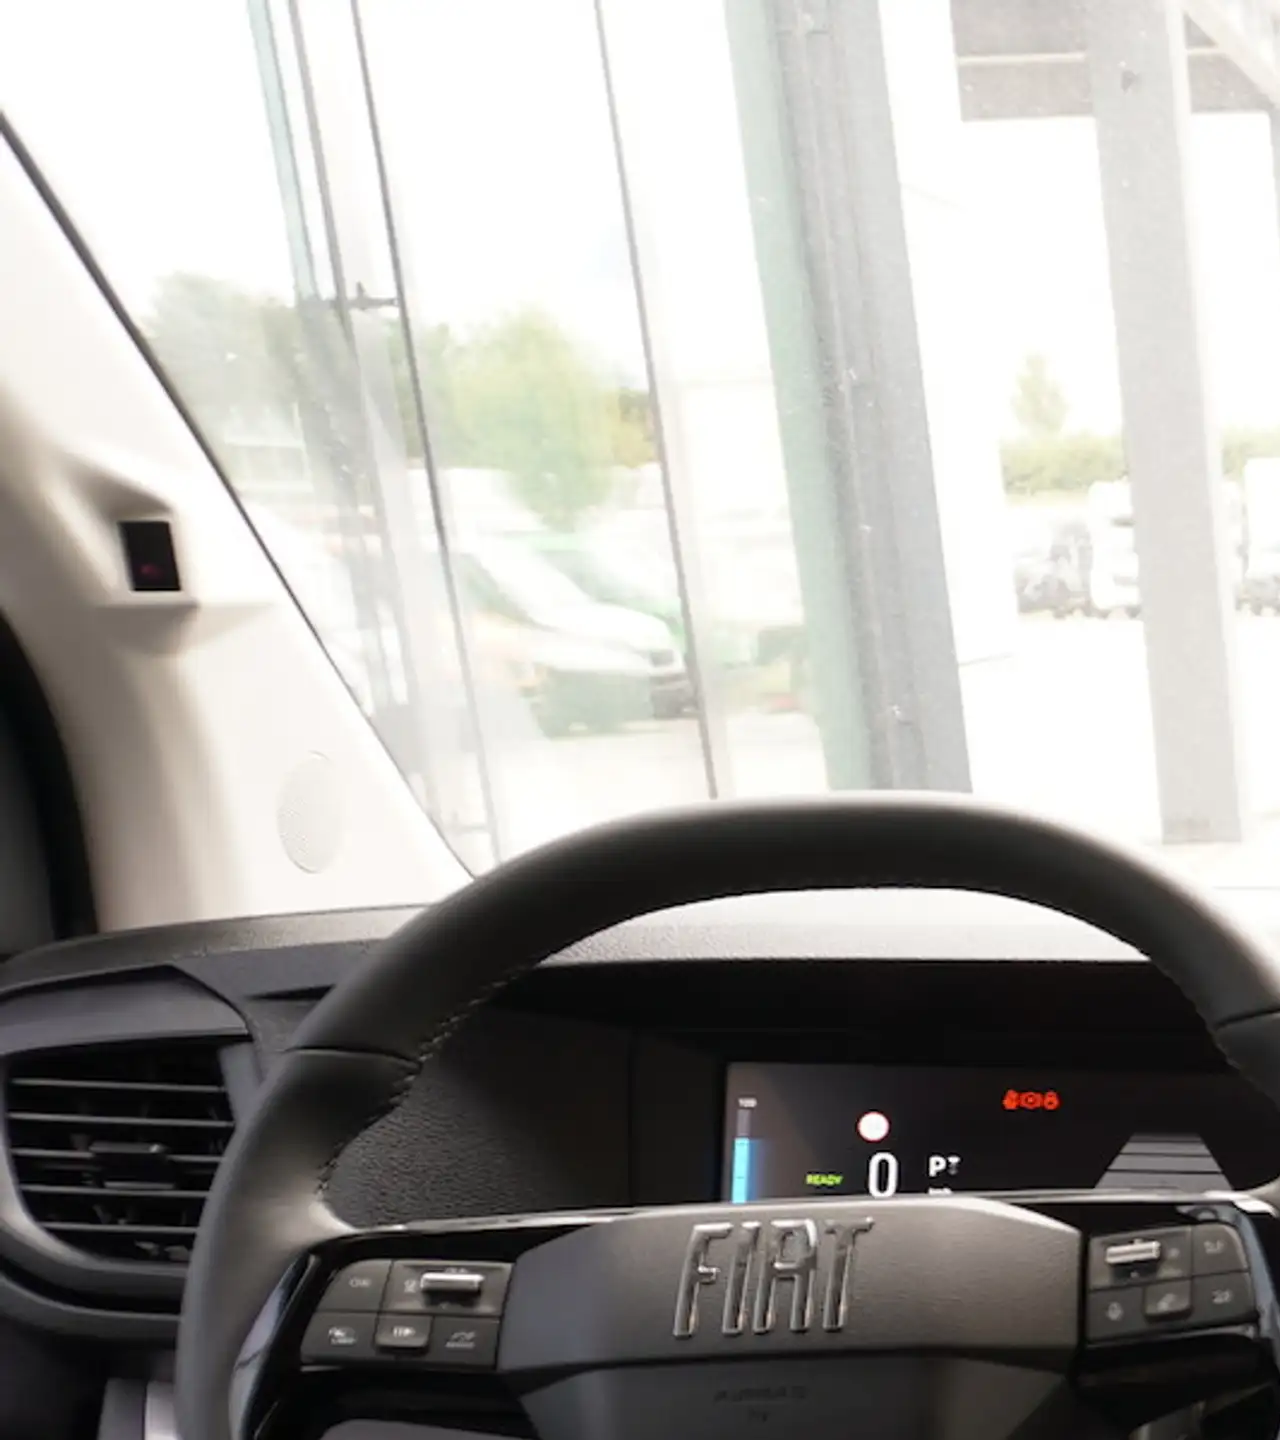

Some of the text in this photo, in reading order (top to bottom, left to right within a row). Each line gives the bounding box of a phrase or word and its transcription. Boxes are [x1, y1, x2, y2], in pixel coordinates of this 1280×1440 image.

[805, 1173, 844, 1186] READY
[867, 1151, 899, 1199] 0
[673, 1216, 876, 1340] FIAT
